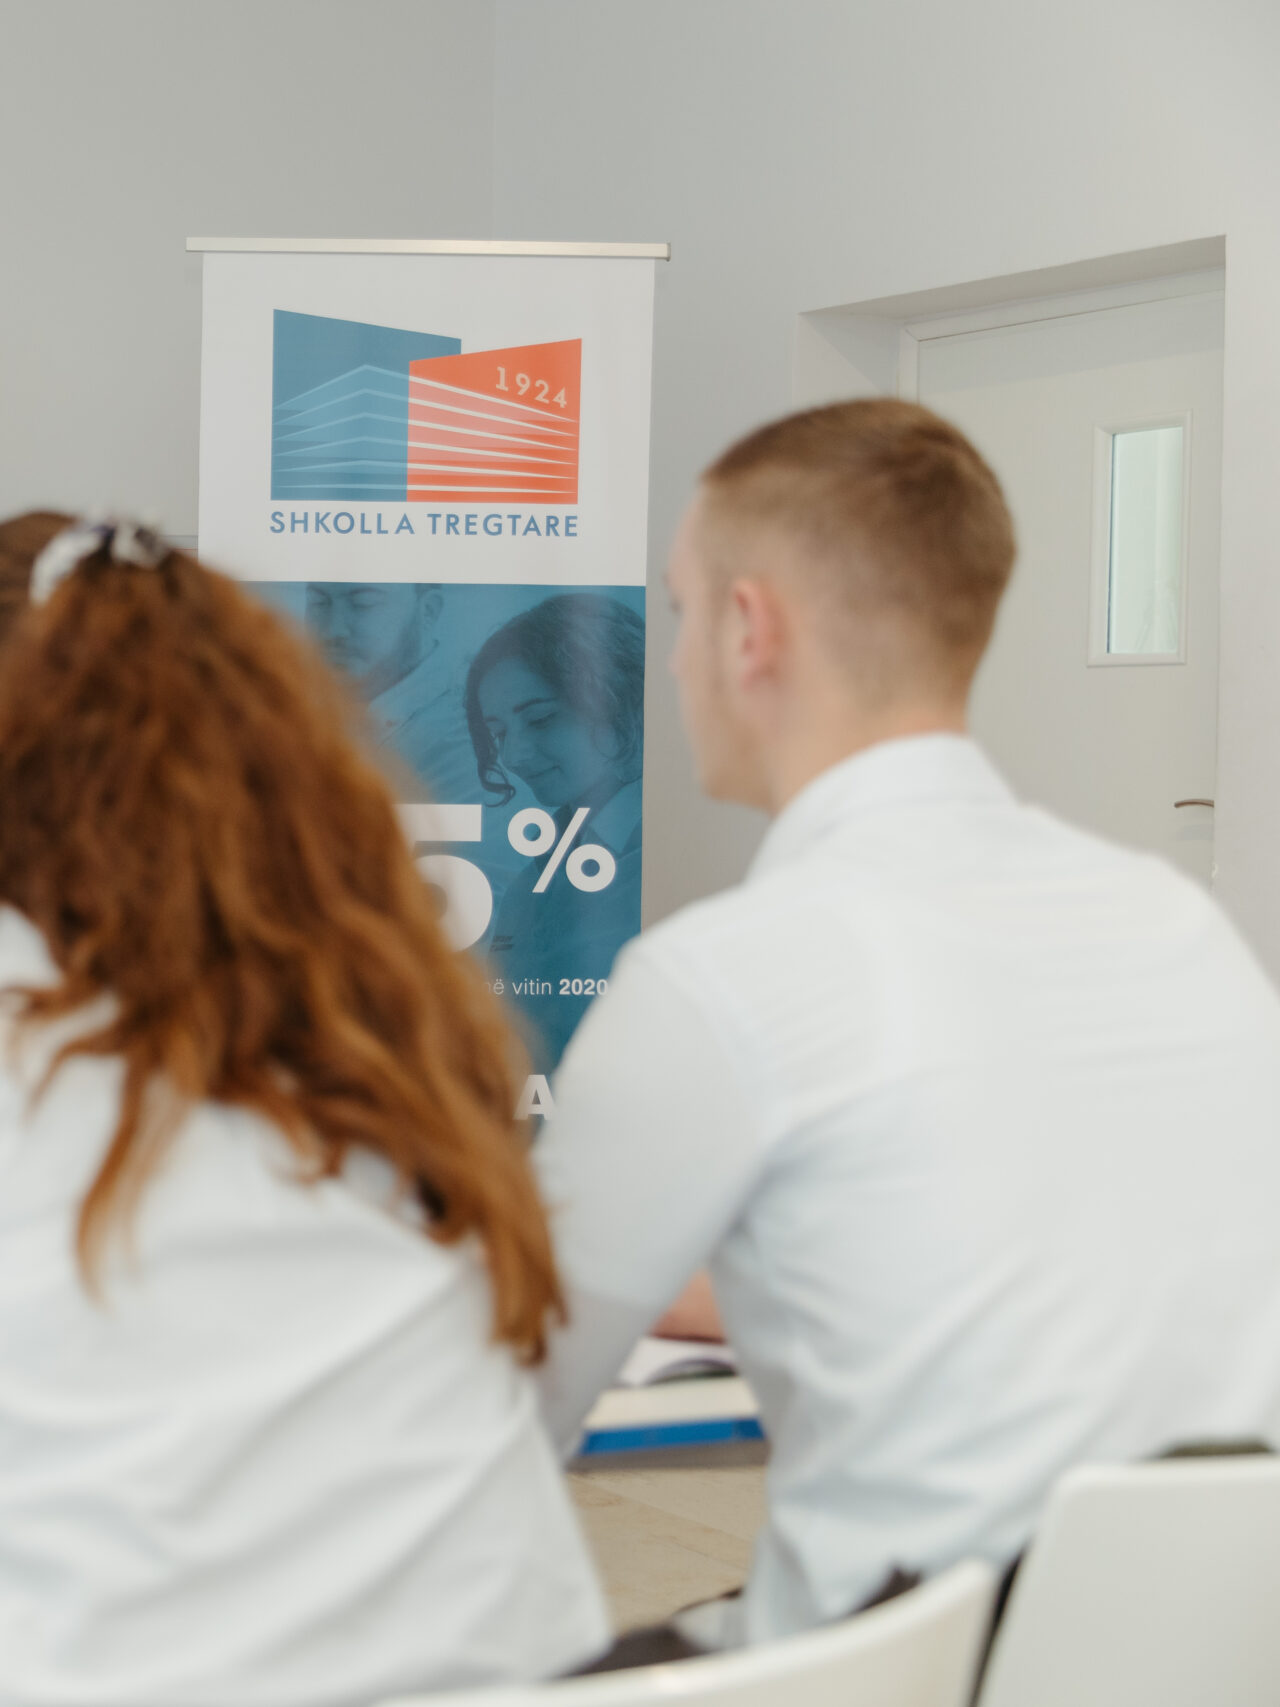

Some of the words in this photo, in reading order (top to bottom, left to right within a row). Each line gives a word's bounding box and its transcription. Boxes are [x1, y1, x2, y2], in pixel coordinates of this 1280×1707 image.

[494, 366, 568, 408] 1924
[269, 511, 414, 535] SHKOLLA
[426, 513, 578, 537] TREGTARE
[512, 978, 552, 996] vitin
[558, 978, 609, 996] 2020
